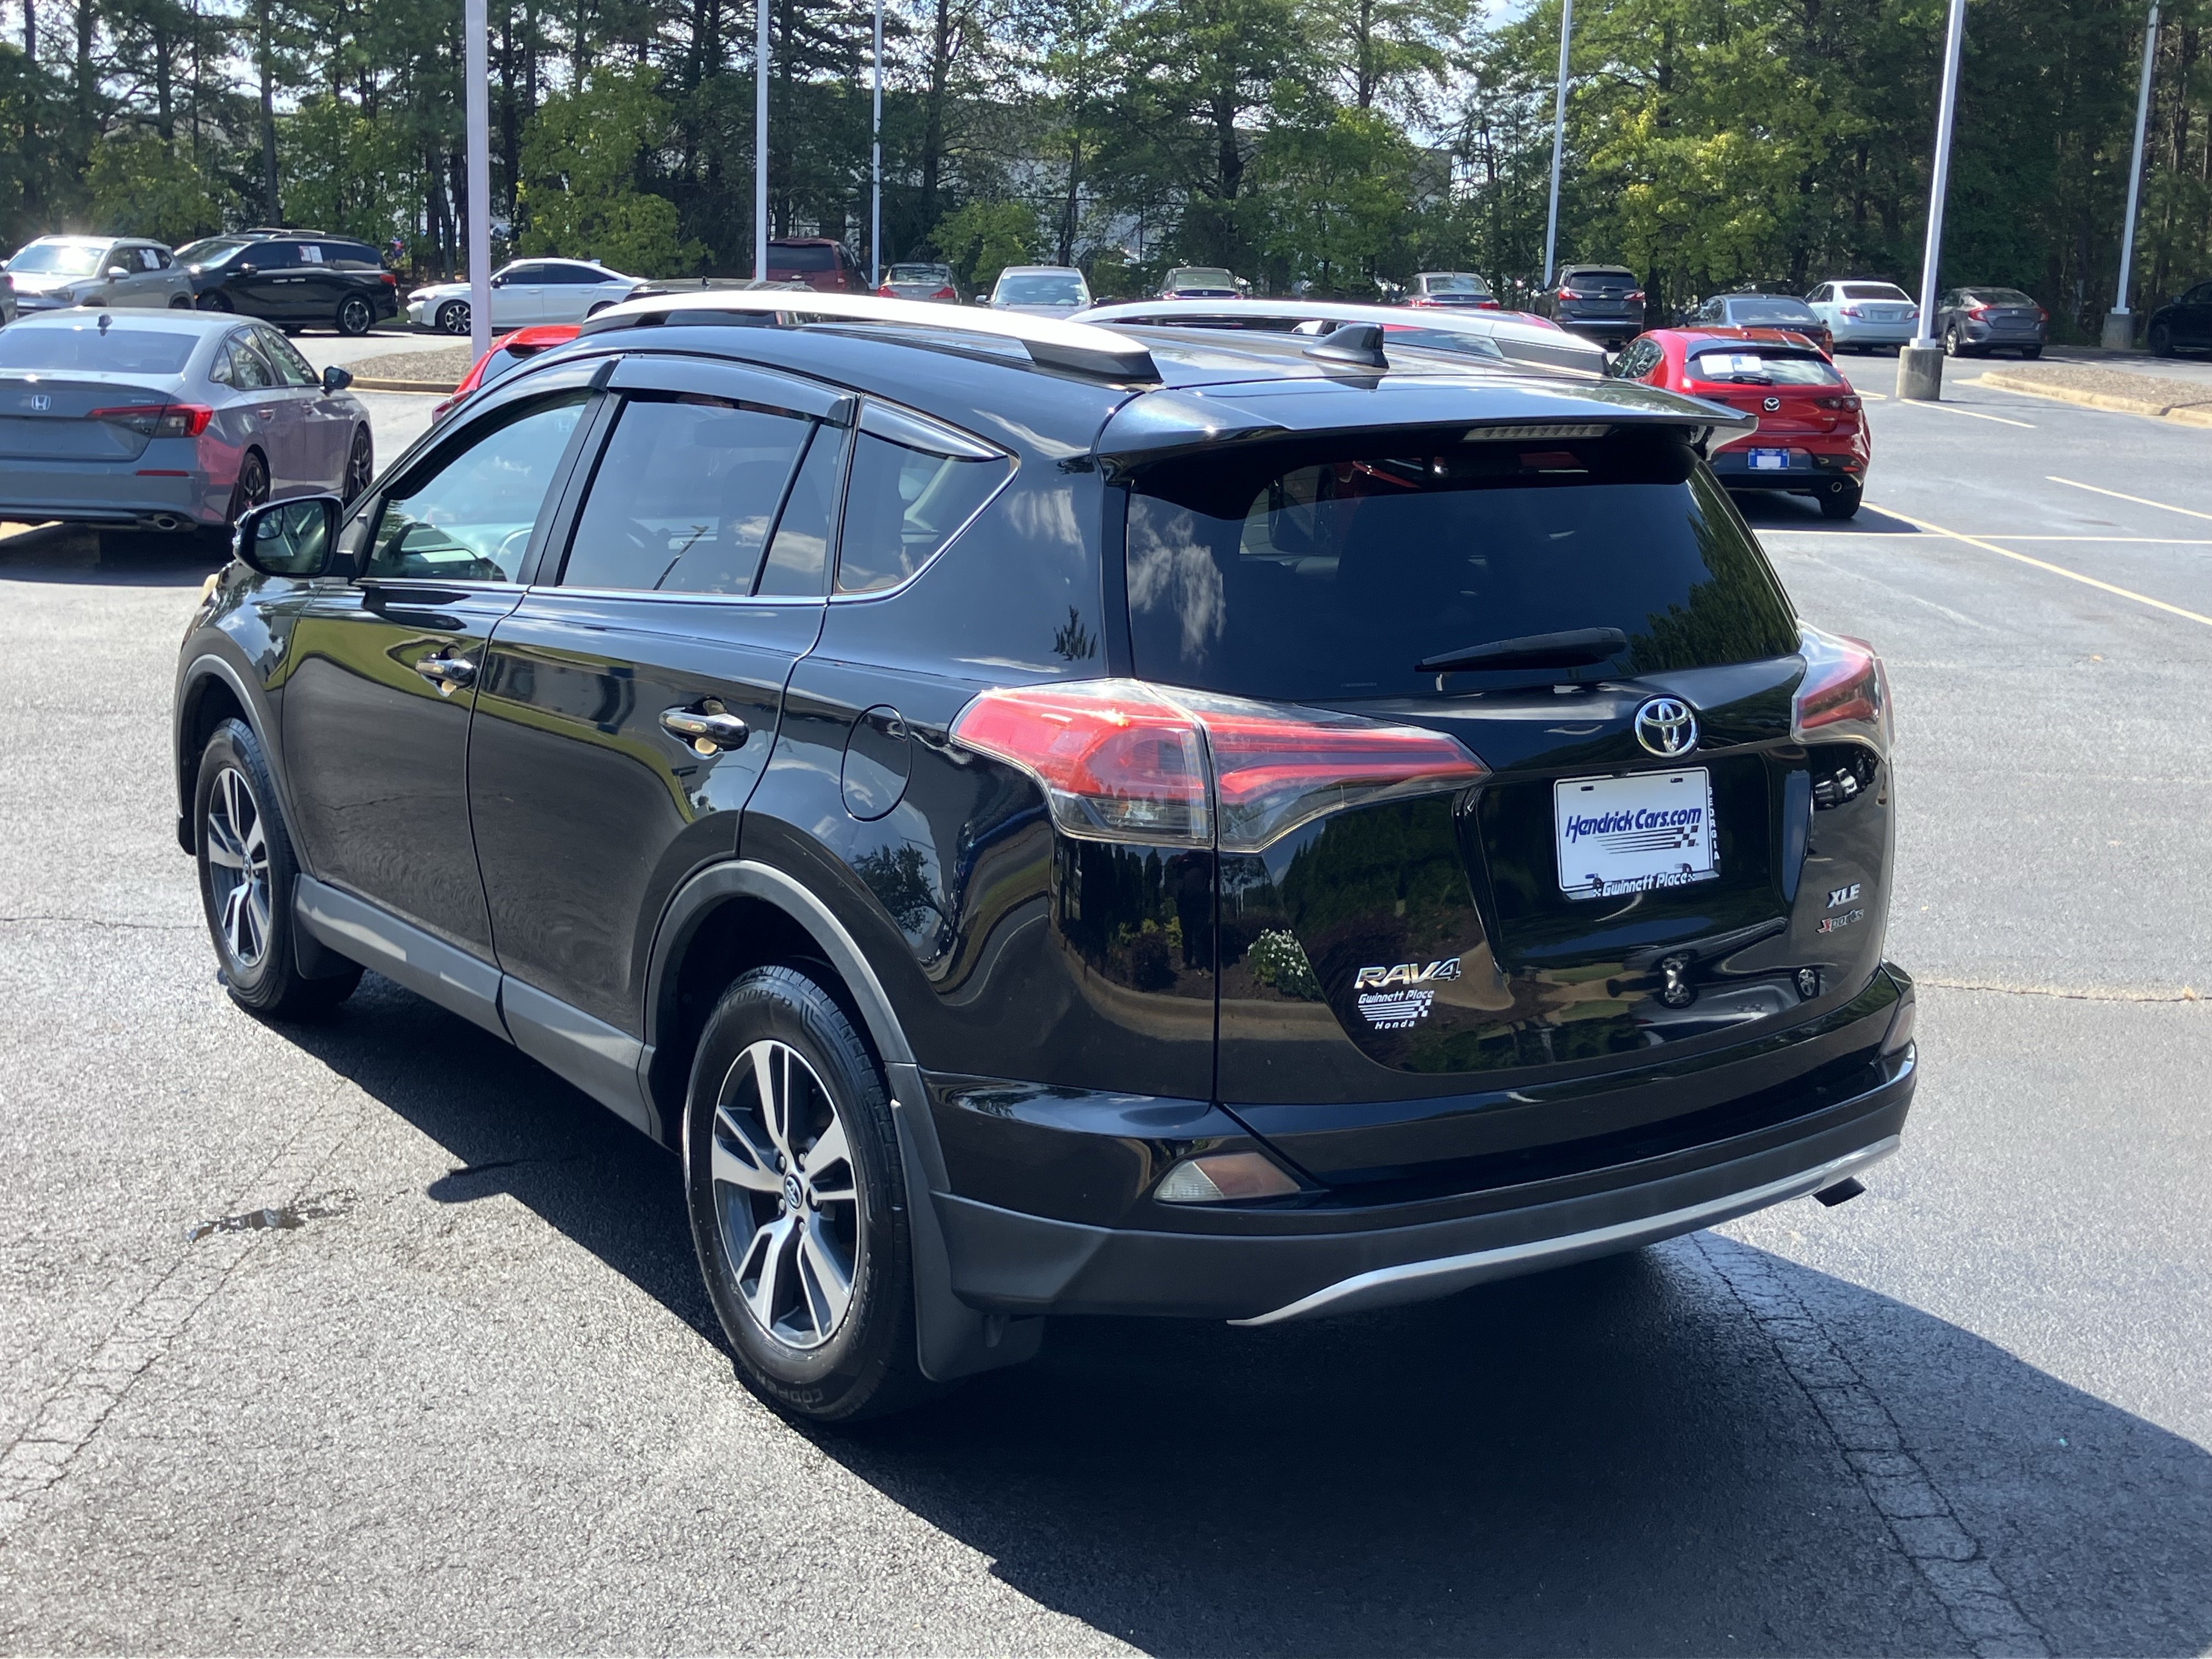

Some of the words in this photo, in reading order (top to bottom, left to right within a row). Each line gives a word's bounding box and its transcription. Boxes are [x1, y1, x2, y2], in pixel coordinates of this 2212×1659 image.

[1602, 876, 1654, 897] Gwinnett
[1655, 872, 1688, 889] Place
[1826, 883, 1860, 909] XLE
[1353, 958, 1462, 989] RAV4
[1358, 990, 1404, 1004] Gwinnett
[1405, 989, 1435, 1001] Place
[1375, 1019, 1415, 1030] Honda
